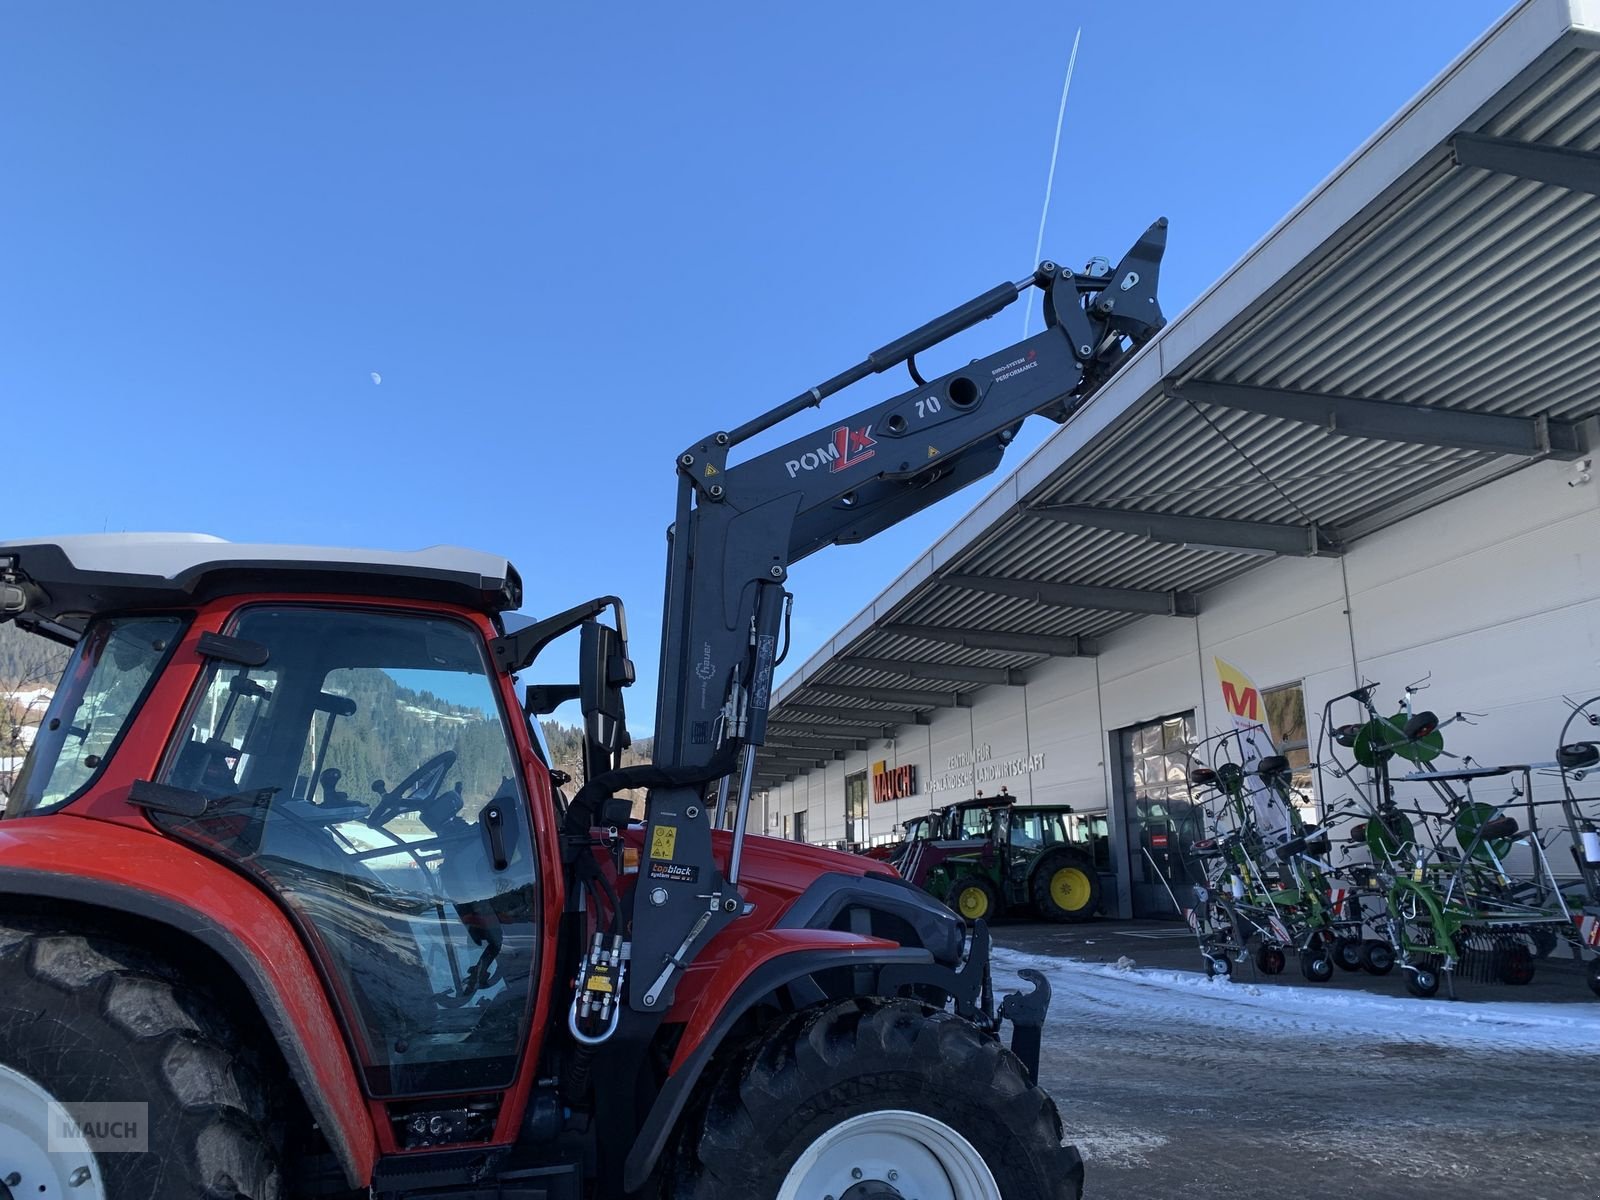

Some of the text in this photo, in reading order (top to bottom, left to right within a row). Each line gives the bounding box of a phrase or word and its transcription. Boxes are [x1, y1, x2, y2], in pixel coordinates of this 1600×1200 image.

[995, 360, 1038, 383] PERFORMANCE
[915, 396, 941, 418] 70
[1222, 681, 1257, 720] M
[947, 743, 991, 770] ZENTRUM FÜR
[976, 753, 1045, 782] LANDWIRTSCHAFT
[873, 764, 913, 804] MAUCH
